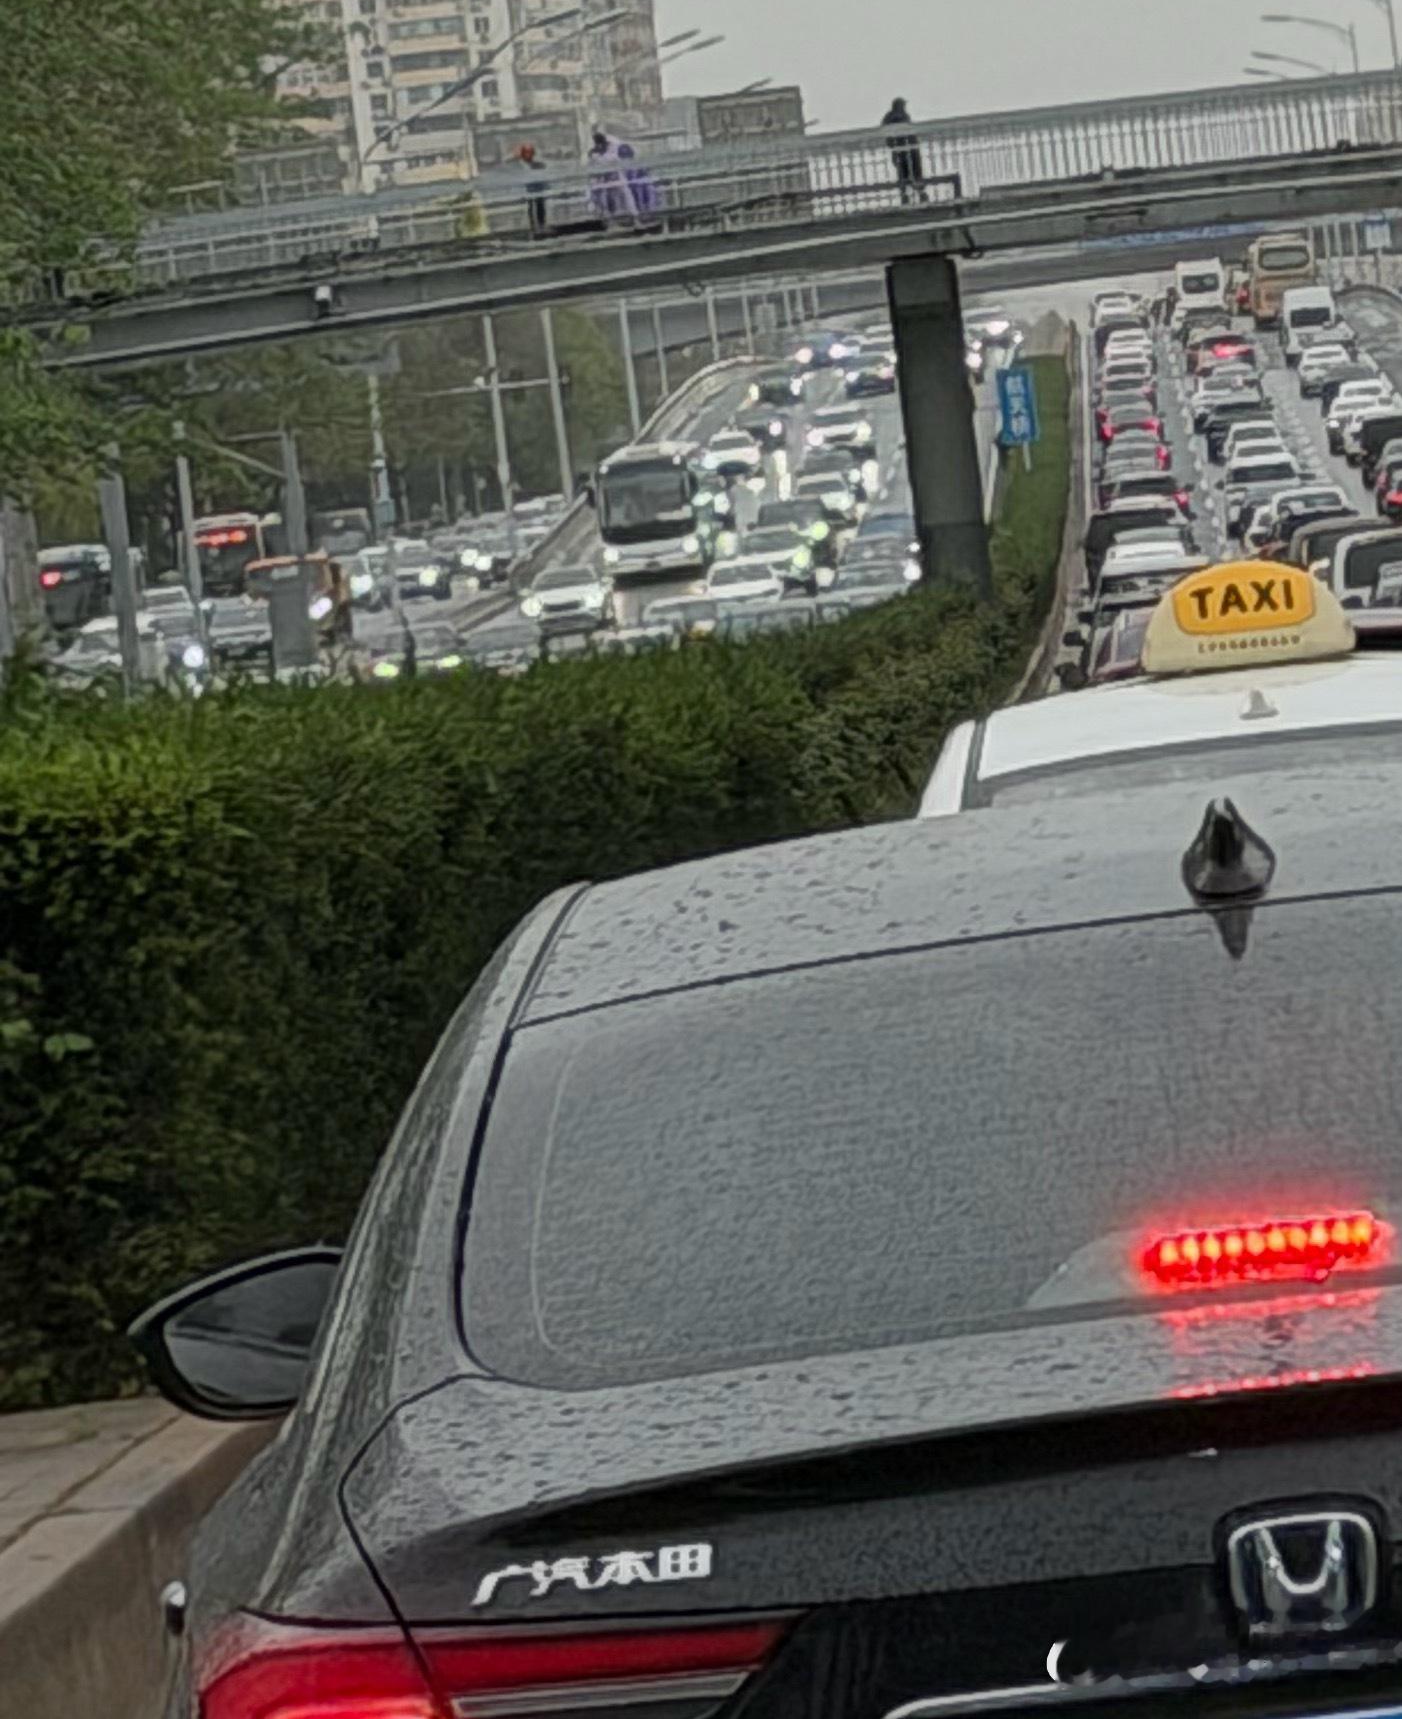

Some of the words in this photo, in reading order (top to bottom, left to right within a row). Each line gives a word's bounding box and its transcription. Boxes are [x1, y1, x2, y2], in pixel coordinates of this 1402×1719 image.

[1190, 578, 1295, 619] TAXI
[470, 1542, 714, 1607] 广汽本田
